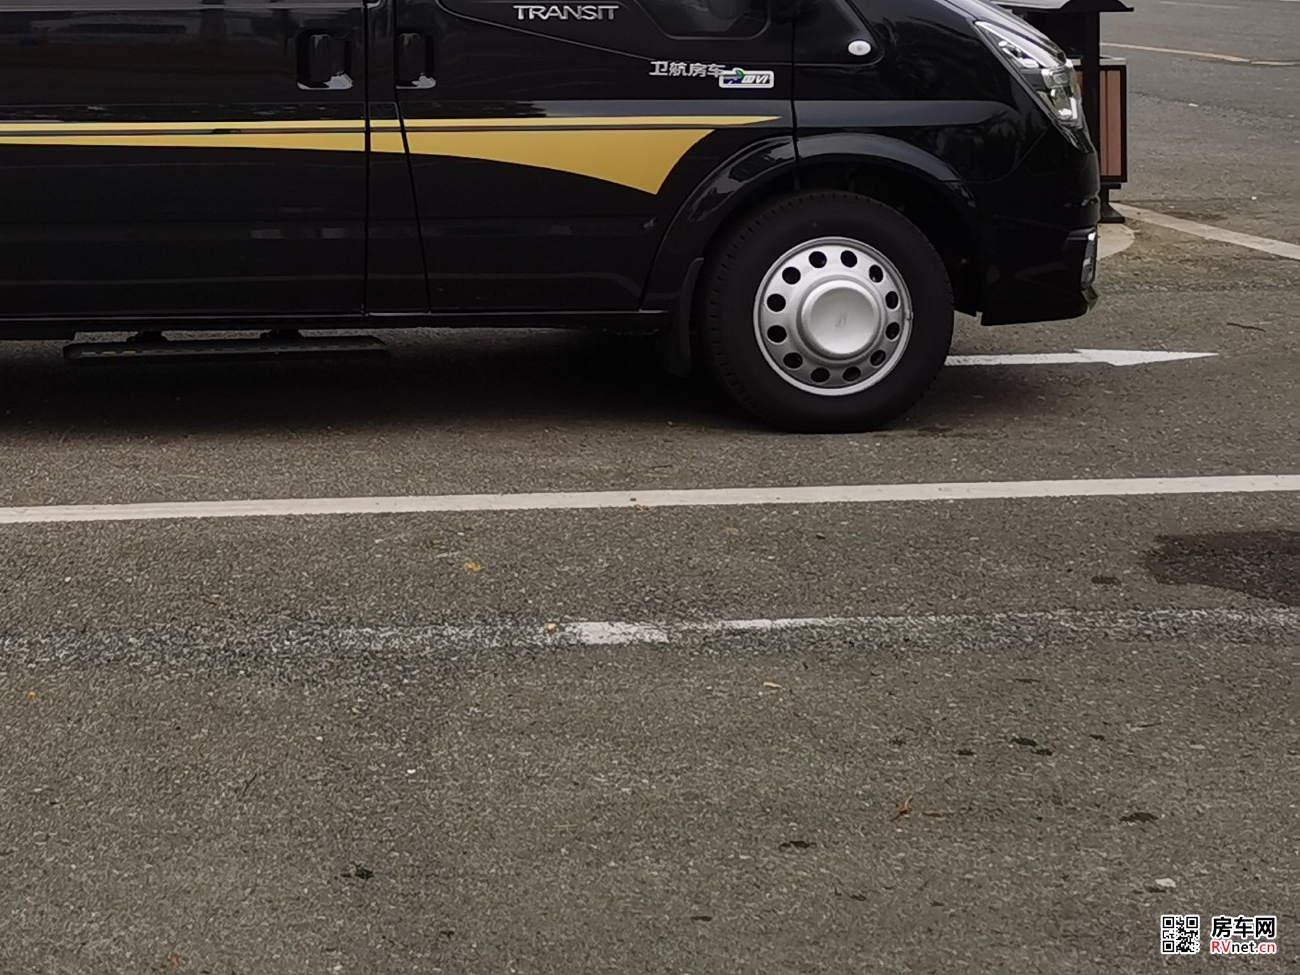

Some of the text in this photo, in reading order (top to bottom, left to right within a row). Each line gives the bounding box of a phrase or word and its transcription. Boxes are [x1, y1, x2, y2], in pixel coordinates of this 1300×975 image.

[513, 5, 619, 20] TRANSIT
[648, 61, 726, 78] 卫航房车
